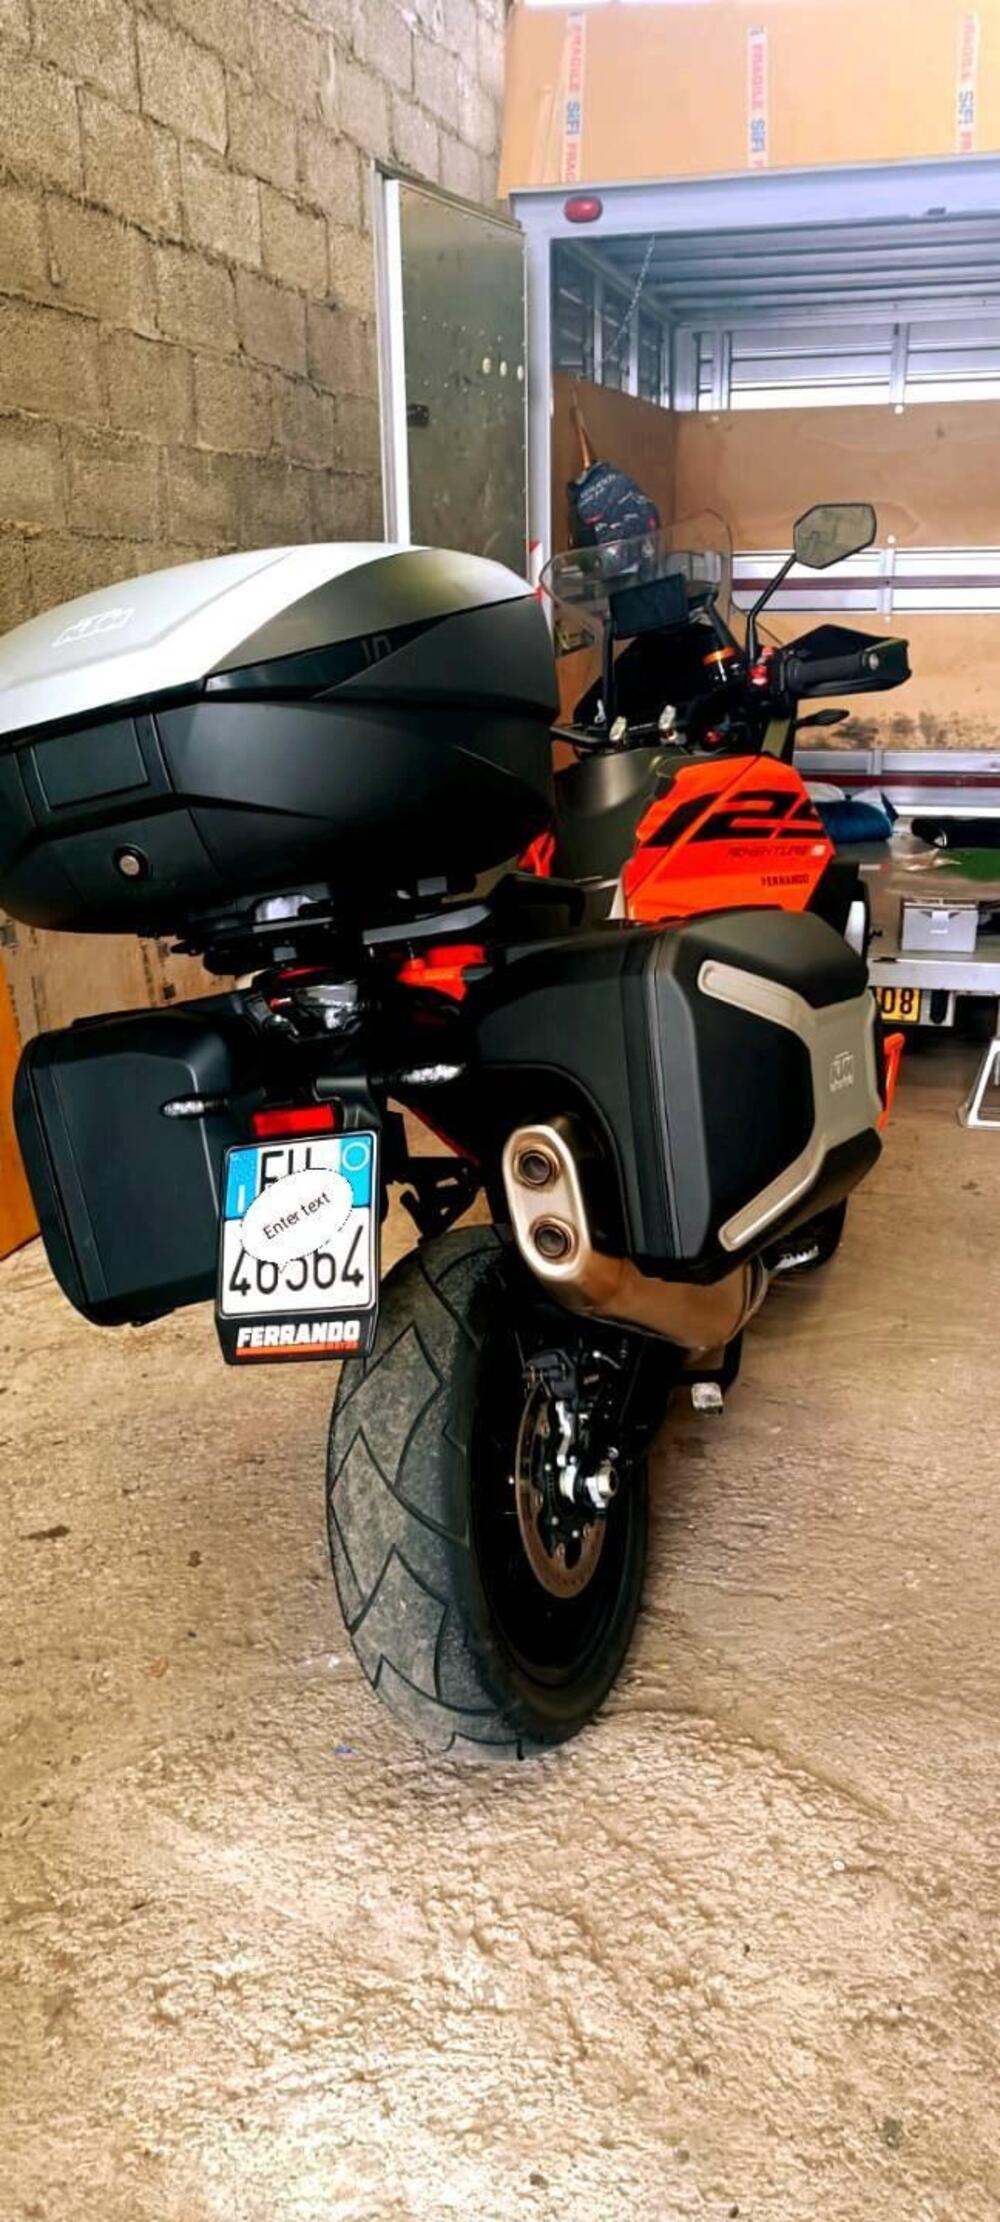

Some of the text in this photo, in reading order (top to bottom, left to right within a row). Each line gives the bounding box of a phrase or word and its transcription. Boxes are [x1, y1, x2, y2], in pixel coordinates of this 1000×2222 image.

[569, 24, 582, 93] FRAGILE
[752, 44, 764, 110] FRAGILE
[881, 988, 914, 1014] 08
[236, 1320, 360, 1349] FERRANDO
